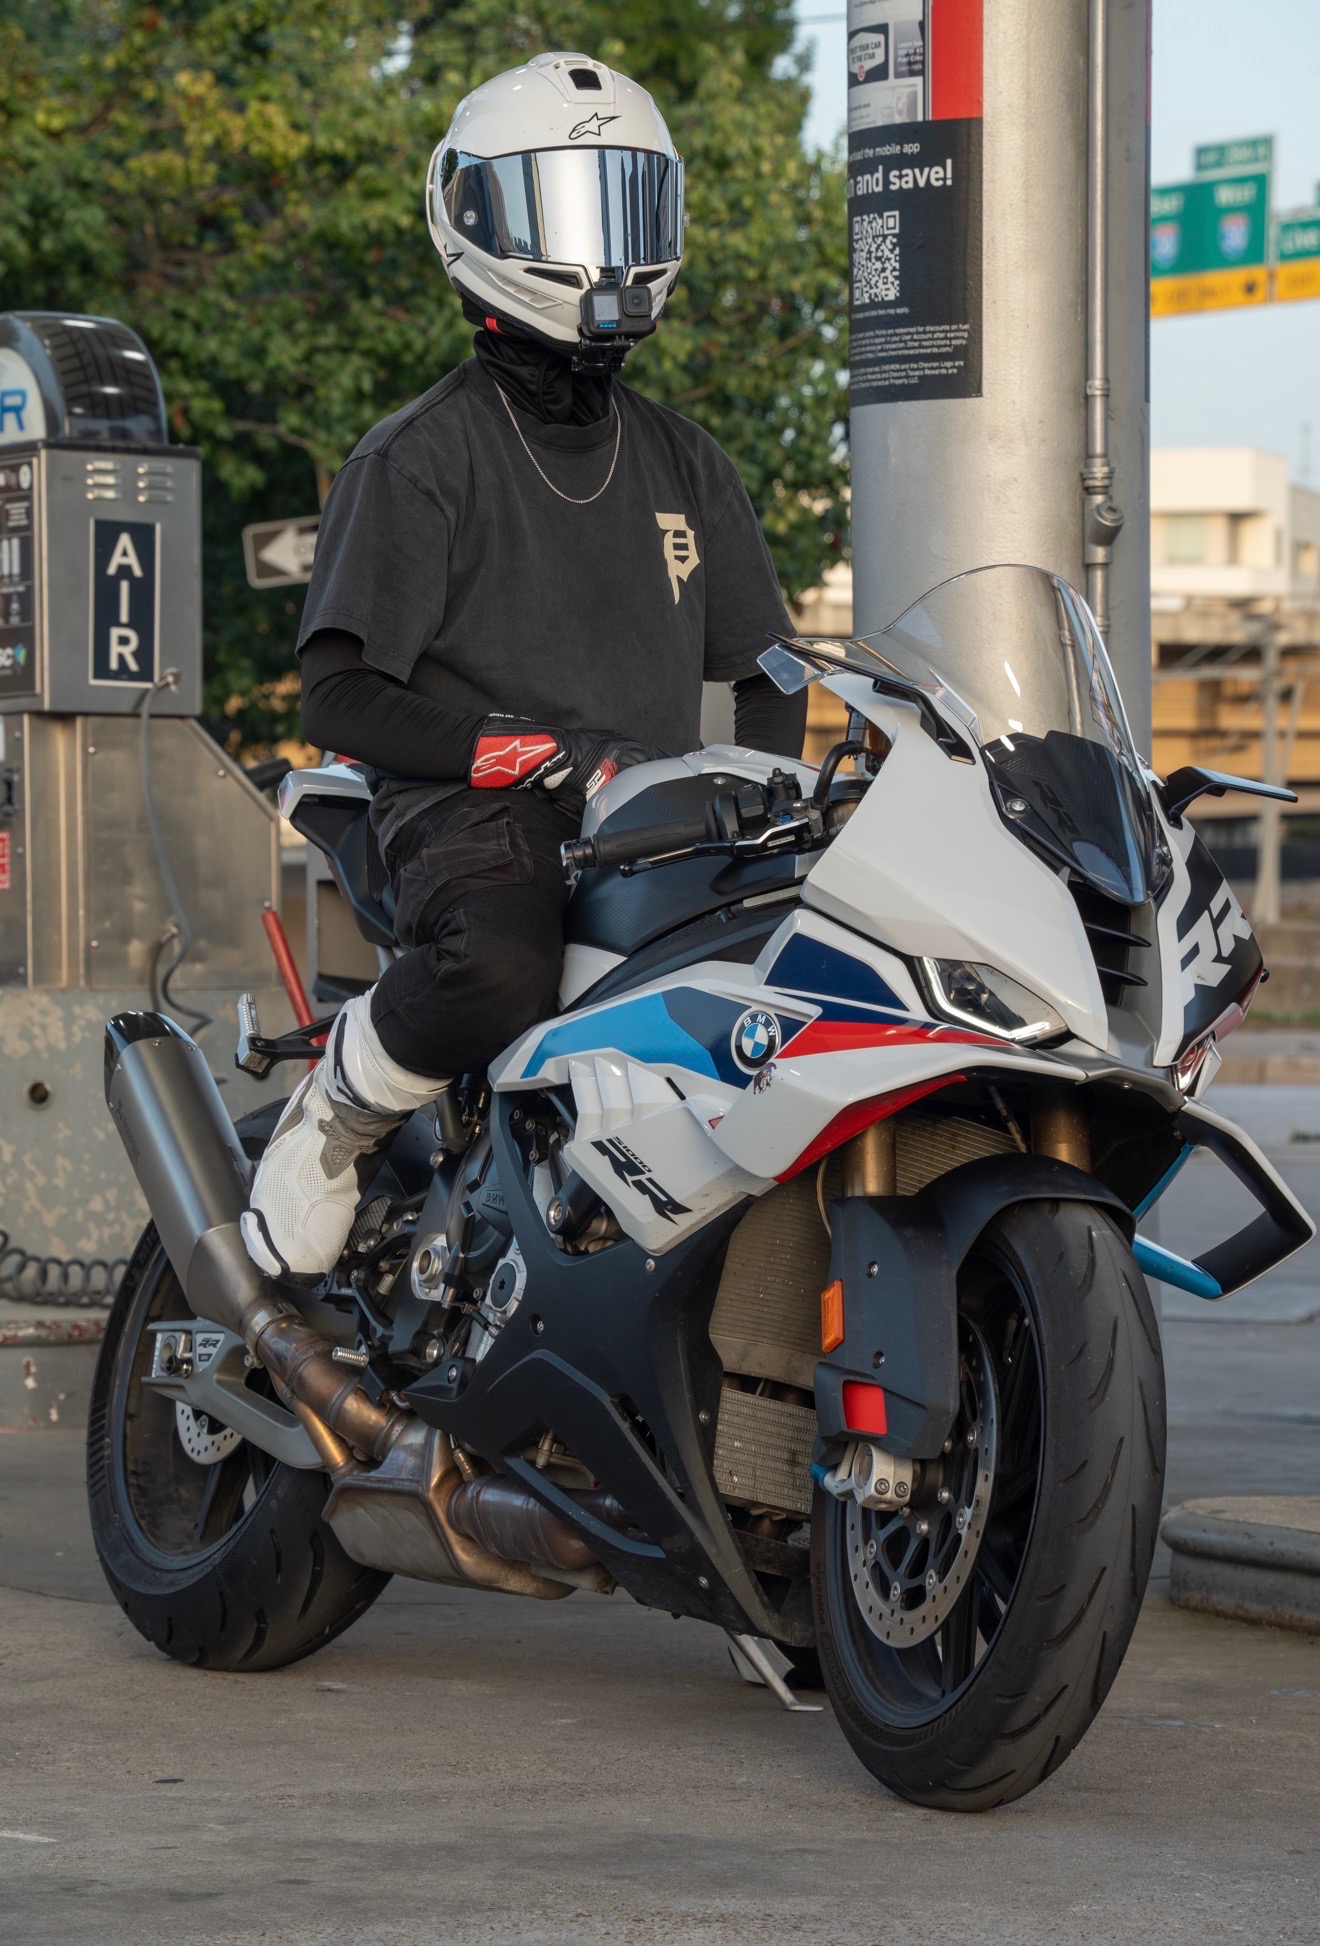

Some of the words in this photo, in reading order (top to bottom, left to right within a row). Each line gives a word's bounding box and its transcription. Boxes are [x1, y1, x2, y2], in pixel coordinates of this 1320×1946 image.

[863, 52, 876, 61] STAR
[870, 41, 881, 50] CAR
[864, 147, 874, 159] the
[874, 143, 901, 156] mobile
[902, 143, 920, 155] app
[856, 164, 883, 196] and
[889, 158, 952, 191] save!
[921, 339, 950, 347] restrictions
[951, 338, 968, 346] apply.
[106, 532, 144, 672] AIR
[744, 1013, 776, 1037] BMW
[612, 1136, 653, 1173] S1000
[590, 1139, 693, 1226] RR
[198, 1339, 221, 1349] RR
[815, 1576, 826, 1626] POWER
